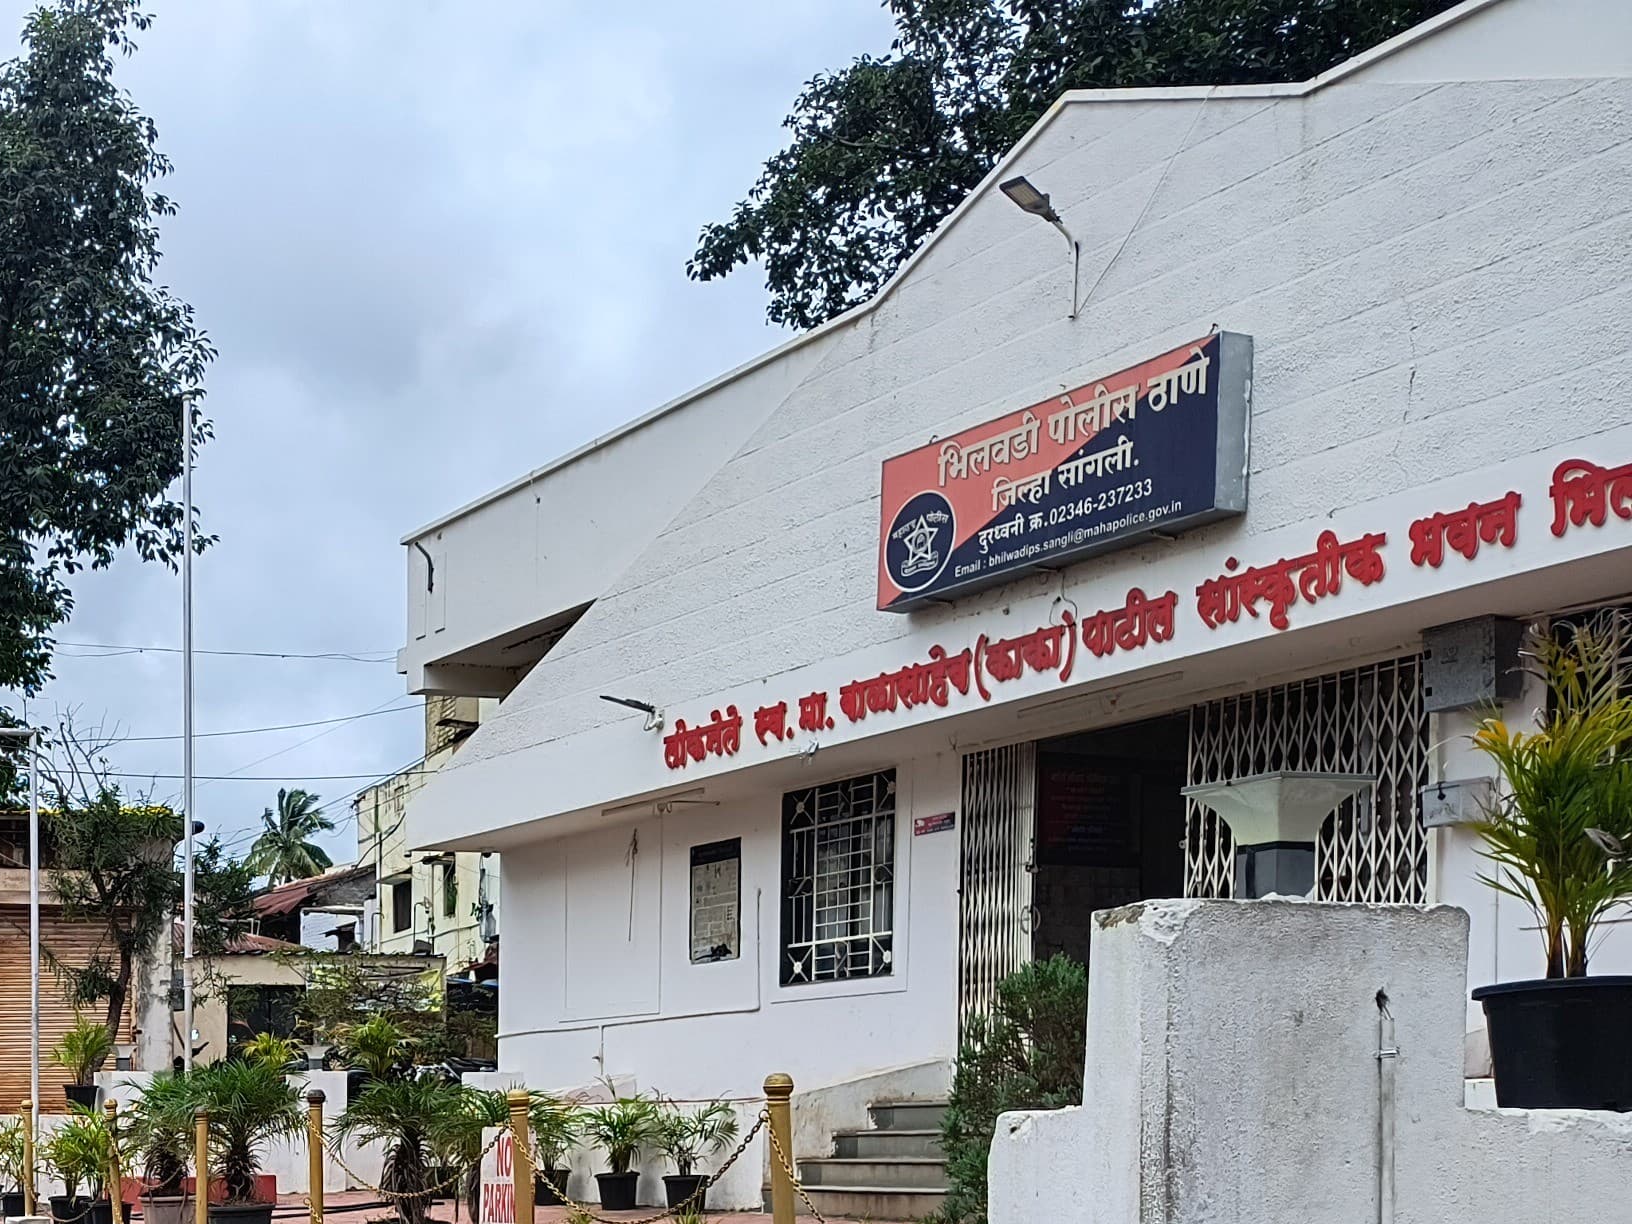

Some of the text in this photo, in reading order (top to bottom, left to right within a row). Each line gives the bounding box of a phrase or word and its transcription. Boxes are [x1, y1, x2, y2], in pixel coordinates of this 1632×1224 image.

[937, 346, 1210, 487] भिलवडी पोलीस ठाणे
[991, 435, 1140, 512] जिल्हा सांगली.
[954, 559, 981, 578] Email
[988, 500, 1182, 568] bhilwadips.sangli@mahapolice.gov.in
[978, 513, 1024, 554] दुरध्वनी
[1082, 588, 1178, 657] पाटील
[1409, 490, 1522, 568] भवन
[497, 1136, 513, 1177] NO
[482, 1183, 516, 1224] PARKIN
